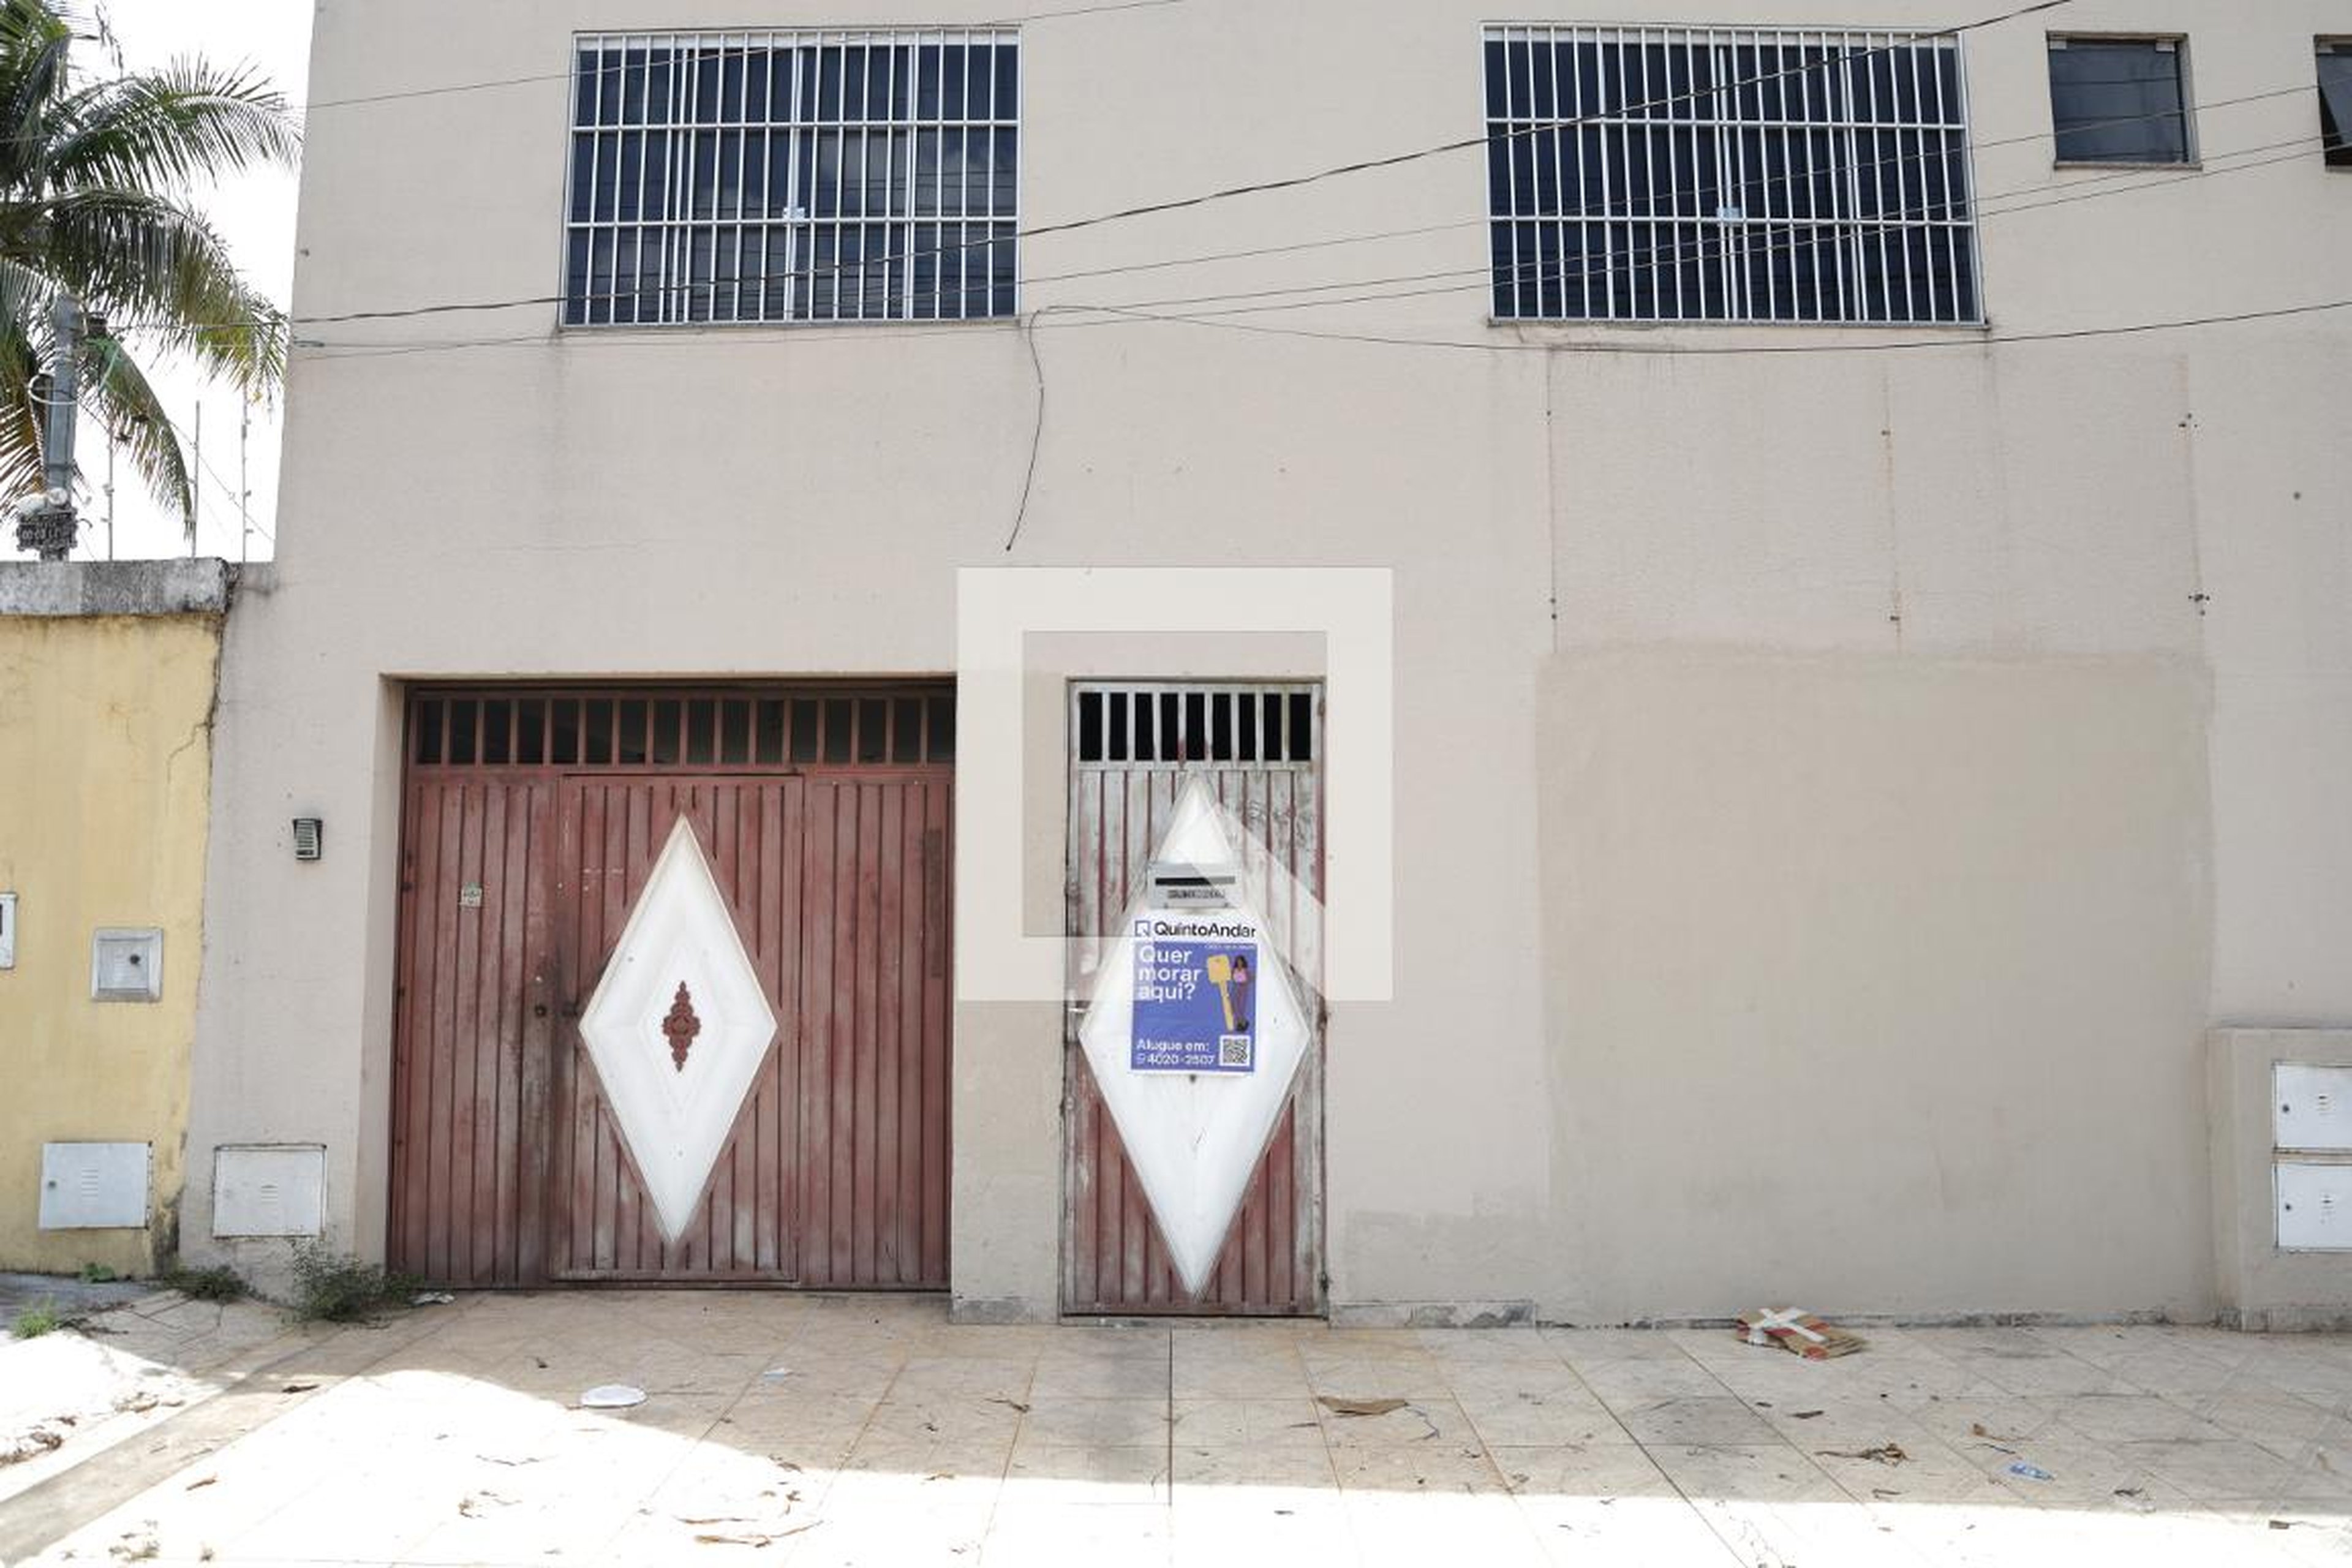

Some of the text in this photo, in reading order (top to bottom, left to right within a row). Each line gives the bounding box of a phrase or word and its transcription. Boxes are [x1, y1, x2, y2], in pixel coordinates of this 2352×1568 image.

[1154, 921, 1256, 937] QuintoAndar
[1139, 945, 1193, 963] Quer
[1139, 968, 1202, 981] morar
[1139, 982, 1196, 1003] aqui?
[1137, 1039, 1210, 1052] Alugue em:
